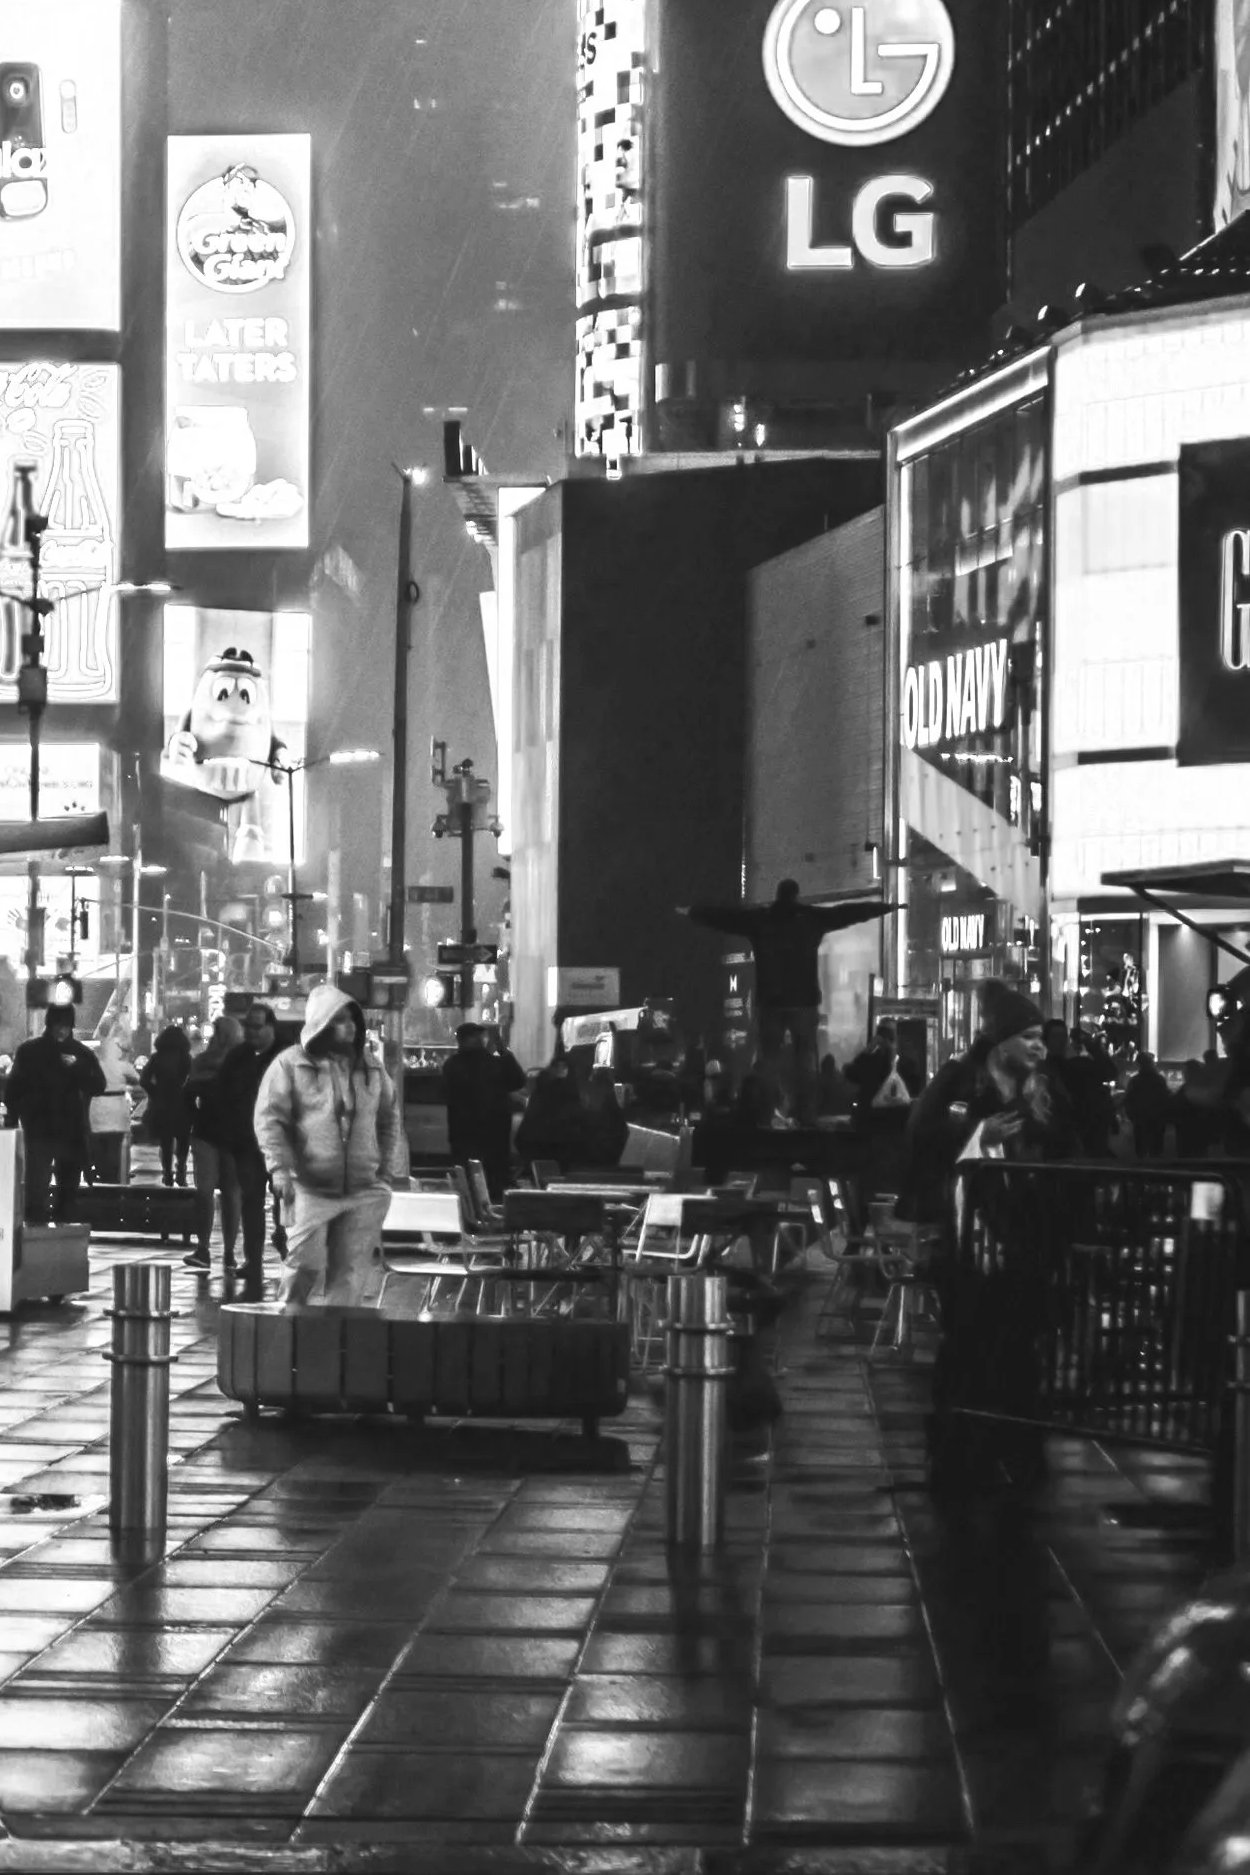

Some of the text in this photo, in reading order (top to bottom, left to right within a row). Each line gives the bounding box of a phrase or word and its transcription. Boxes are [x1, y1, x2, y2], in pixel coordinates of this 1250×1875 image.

[785, 175, 937, 269] LG
[191, 232, 287, 255] Green
[204, 253, 291, 281] Giant
[183, 317, 288, 347] LATER
[176, 352, 298, 383] TATERS
[903, 638, 1008, 750] OLD NAVY
[941, 914, 985, 951] OLD NAVY
